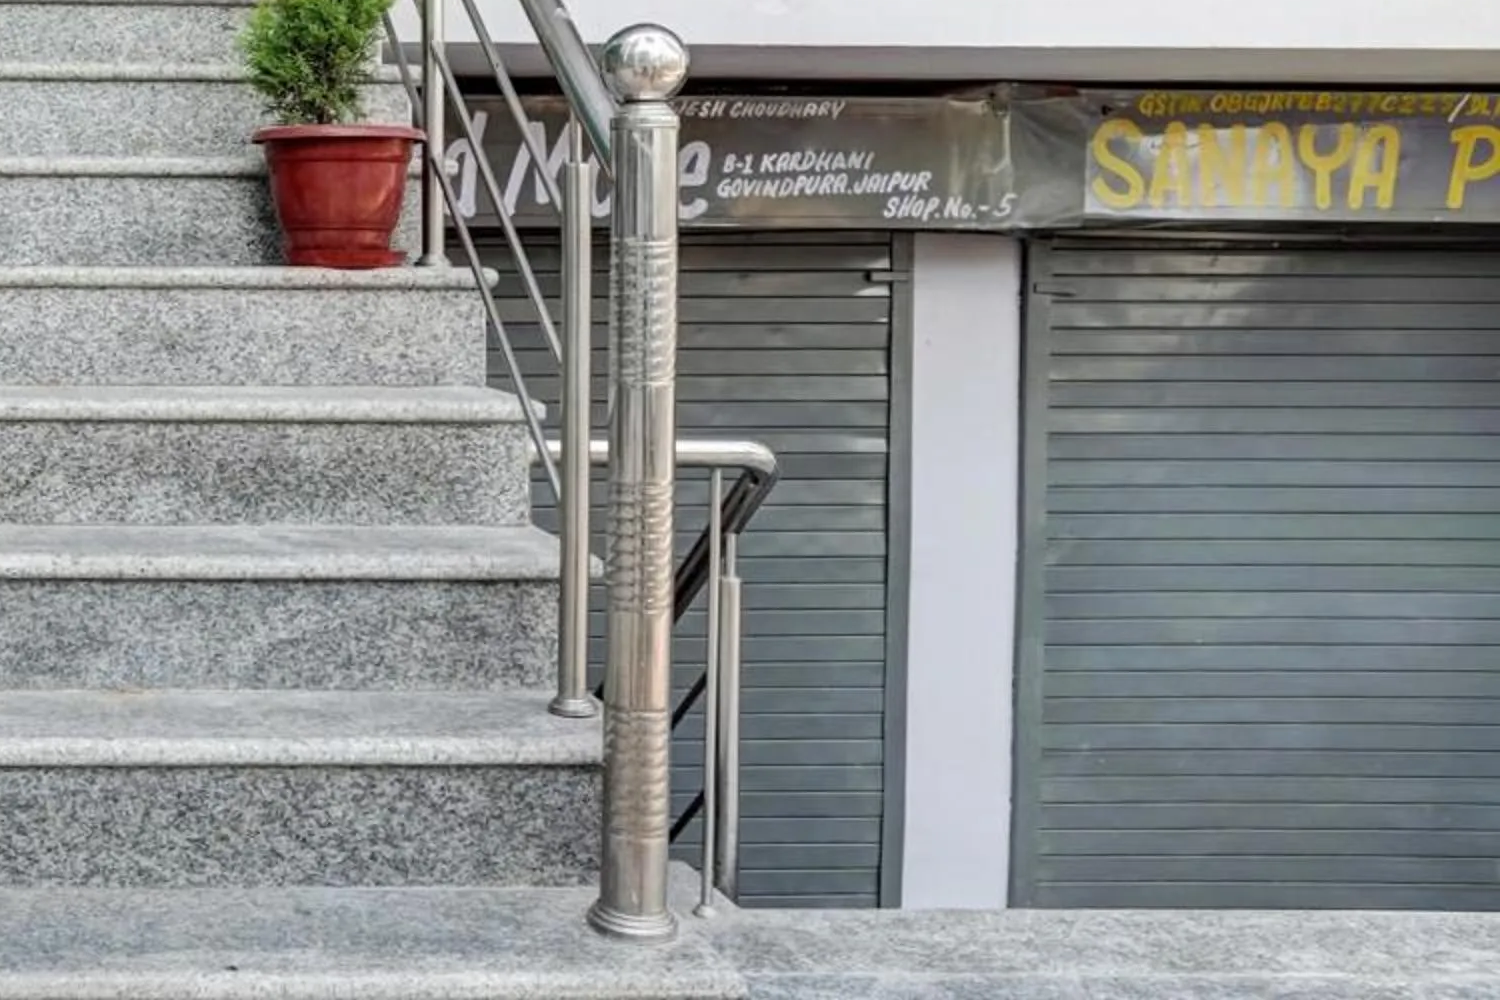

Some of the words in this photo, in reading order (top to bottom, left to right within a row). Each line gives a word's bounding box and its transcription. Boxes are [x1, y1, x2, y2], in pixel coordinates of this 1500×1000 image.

[729, 100, 846, 120] CHOUDHARY
[760, 150, 876, 173] KARDHANI
[1092, 118, 1400, 210] SANAYA
